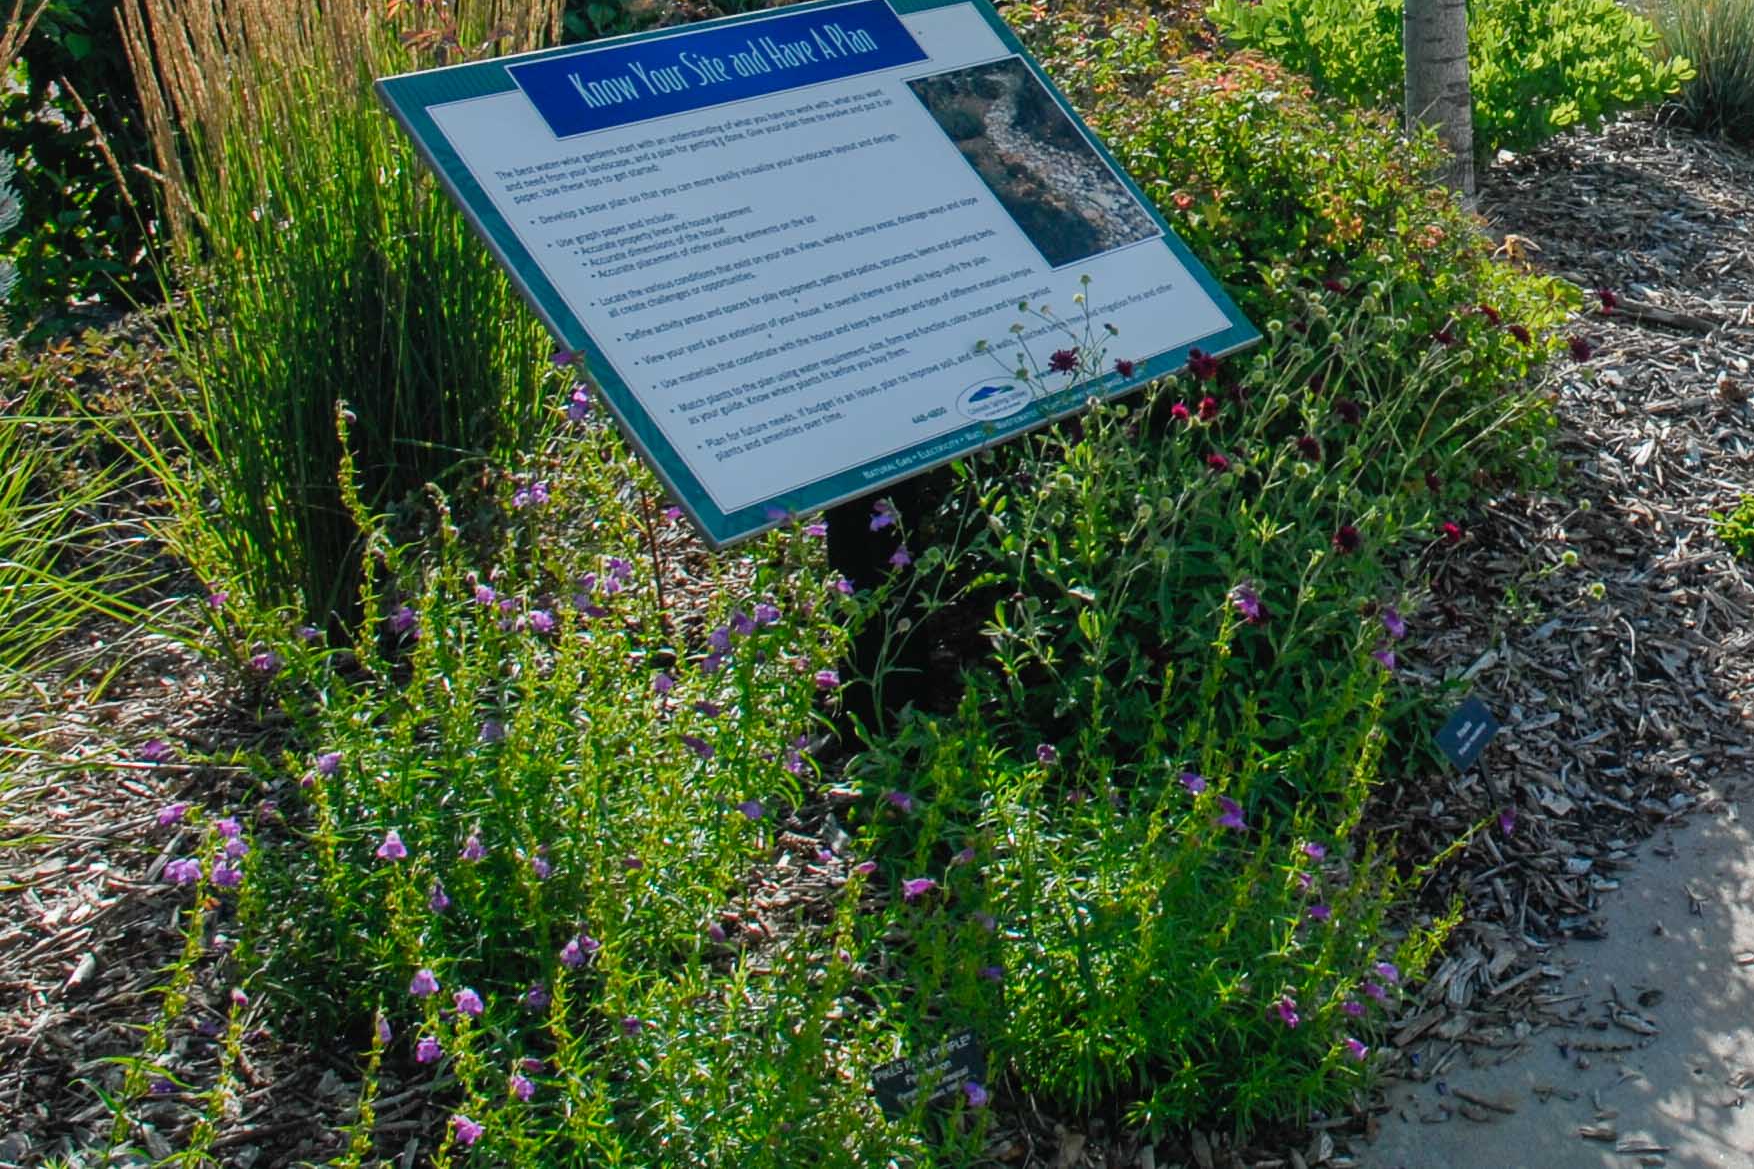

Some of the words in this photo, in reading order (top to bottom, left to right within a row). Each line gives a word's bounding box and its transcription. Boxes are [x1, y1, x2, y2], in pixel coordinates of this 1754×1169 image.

[568, 73, 640, 108] Know
[628, 62, 690, 95] Your
[679, 52, 733, 86] Site
[729, 40, 771, 77] and
[758, 36, 819, 69] Have
[810, 28, 838, 59] A
[824, 23, 878, 56] Plan
[538, 210, 579, 223] Develop
[583, 203, 608, 212] base
[607, 198, 629, 209] plan
[639, 190, 660, 199] that
[659, 187, 677, 196] you
[692, 177, 716, 186] more
[715, 171, 742, 181] easily
[740, 163, 776, 175] visualize
[775, 159, 794, 168] your
[792, 149, 833, 162] landscape
[831, 142, 858, 152] layout
[857, 138, 873, 147] and
[540, 188, 560, 196] Use
[559, 182, 585, 192] these
[584, 178, 603, 186] tips
[613, 171, 628, 181] get
[555, 238, 575, 247] Use
[574, 230, 601, 244] graph
[601, 225, 627, 237] paper
[627, 219, 644, 229] and
[699, 410, 720, 422] your
[745, 393, 771, 405] Know
[770, 385, 796, 397] where
[796, 376, 822, 390] plants
[820, 372, 831, 380] fit
[829, 365, 857, 377] before
[856, 360, 872, 370] you
[870, 355, 888, 363] buy
[705, 437, 727, 448] Plan
[726, 432, 741, 441] for
[740, 423, 769, 436] future
[804, 399, 836, 414] budget
[716, 446, 744, 461] plants
[743, 438, 762, 450] and
[761, 426, 804, 444] amenities
[803, 419, 823, 429] over
